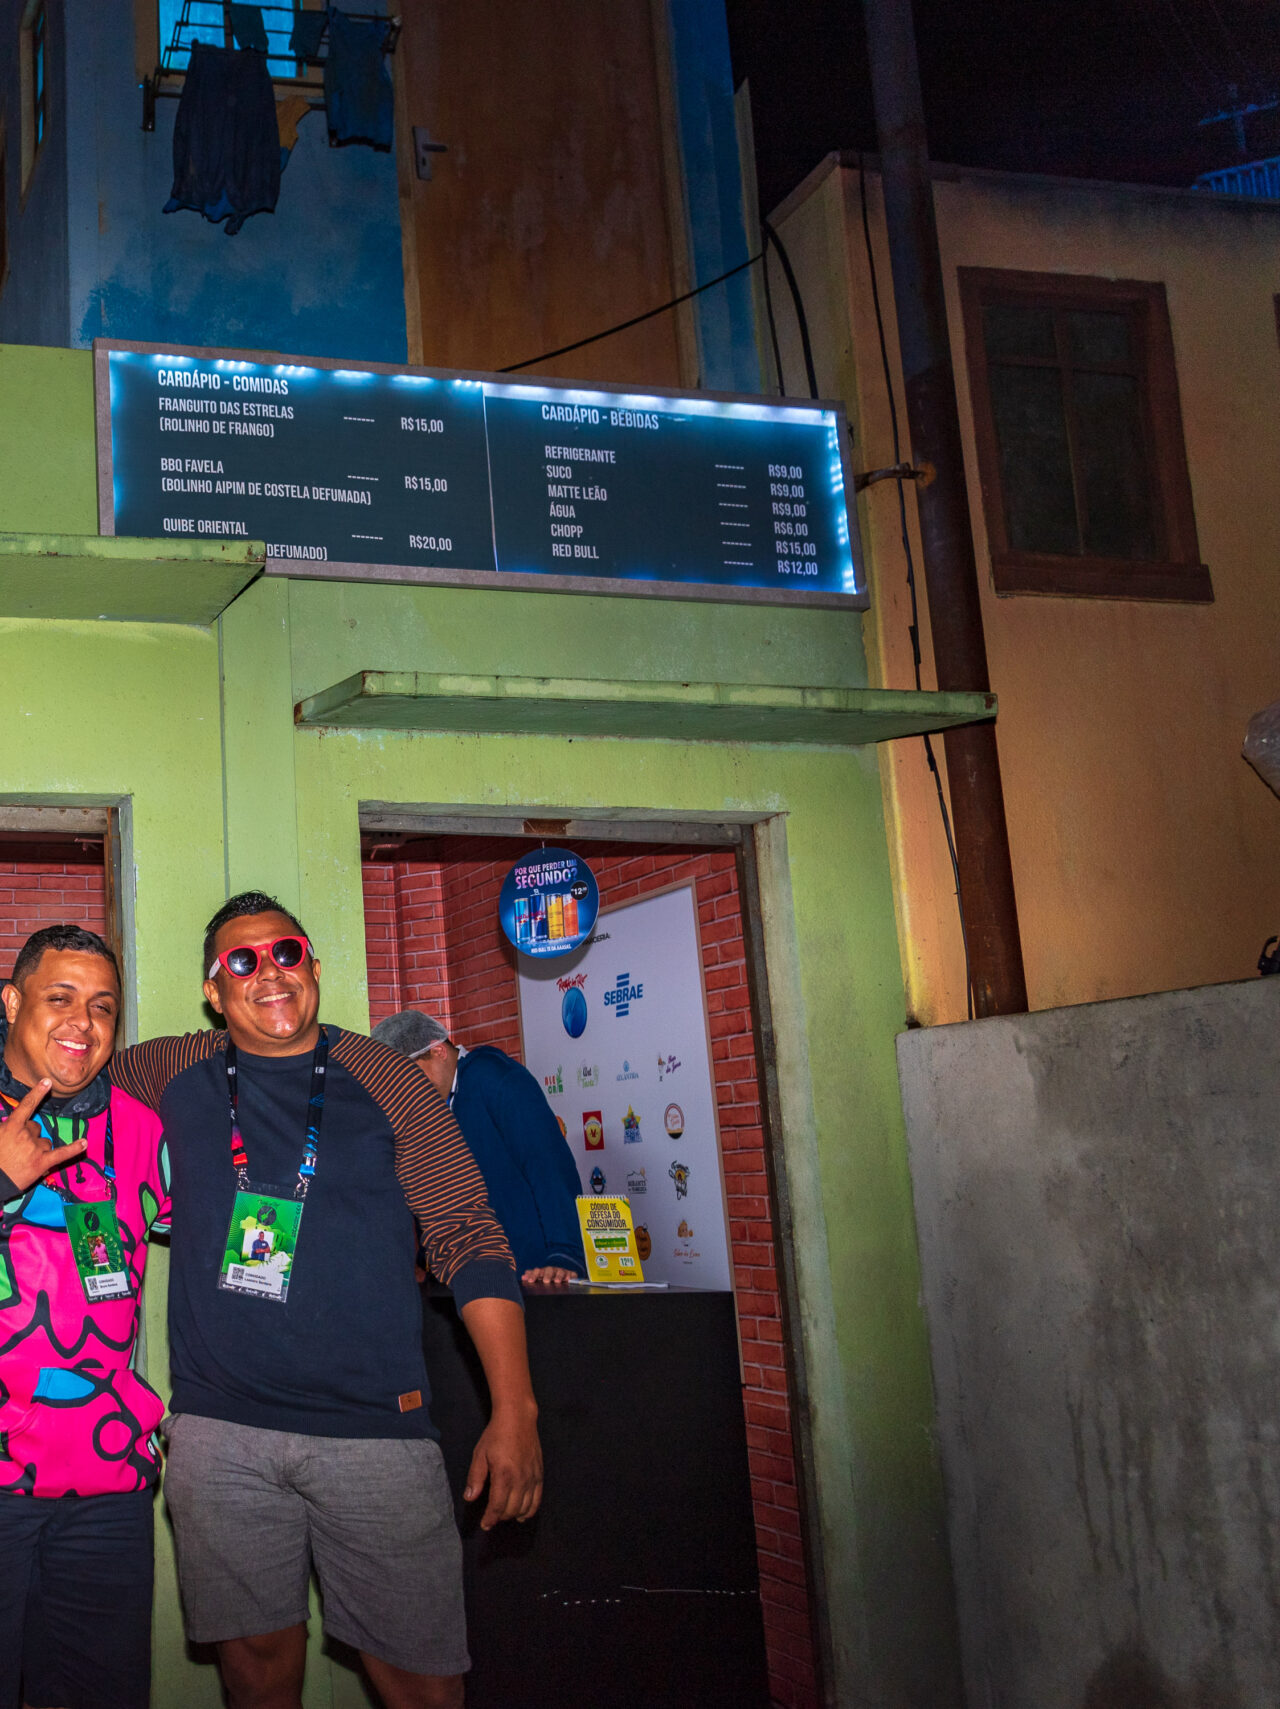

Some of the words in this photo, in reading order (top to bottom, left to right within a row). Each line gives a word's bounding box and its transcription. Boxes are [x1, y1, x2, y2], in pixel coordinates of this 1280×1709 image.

[158, 369, 220, 390] CARDÁPIO
[233, 375, 289, 395] COMIDAS
[159, 397, 217, 413] FRANGUITO
[220, 401, 240, 415] DAS
[243, 402, 294, 419] ESTRELAS
[401, 417, 444, 433] R$15,00
[541, 404, 599, 425] CARDÁPIO
[610, 410, 659, 430] BEBIDAS
[159, 416, 210, 433] (ROLINHO
[212, 421, 226, 434] DE
[228, 421, 274, 438] FRANGO)
[545, 445, 616, 464] REFRIGERANTE
[160, 457, 183, 473] BBQ
[185, 459, 224, 474] FAVELA
[546, 465, 572, 480] SUCO
[768, 464, 803, 480] R$9,00
[161, 477, 213, 493] (BOLINHO
[215, 480, 246, 495] AIPIM
[248, 482, 262, 496] DE
[264, 483, 310, 499] COSTELA
[312, 486, 371, 505] DEFUMADA)
[404, 476, 448, 492] R$15,00
[770, 483, 805, 499] R$9,00
[547, 484, 581, 499] MATTE
[582, 485, 607, 502] LEÃO
[549, 501, 576, 518] ÁGUA
[772, 502, 807, 518] R$9,00
[163, 518, 195, 533] QUIBE
[197, 519, 248, 535] ORIENTAL
[550, 523, 584, 539] CHOPP
[774, 521, 809, 537] R$6,00
[409, 534, 453, 551] R$20,00
[775, 540, 817, 556] R$15,00
[266, 543, 328, 561] DEFUMADO)
[552, 543, 572, 557] RED
[574, 545, 600, 559] BULL
[777, 560, 818, 576] R$12,00
[515, 867, 527, 876] POR
[528, 864, 541, 874] QUE
[542, 860, 565, 871] PERDER
[515, 867, 578, 889] SEGUNDO?
[603, 983, 643, 1006] SEBRAE
[590, 1210, 611, 1219] DEFESA
[612, 1211, 621, 1219] DO
[586, 1219, 627, 1228] CONSUMIDOR
